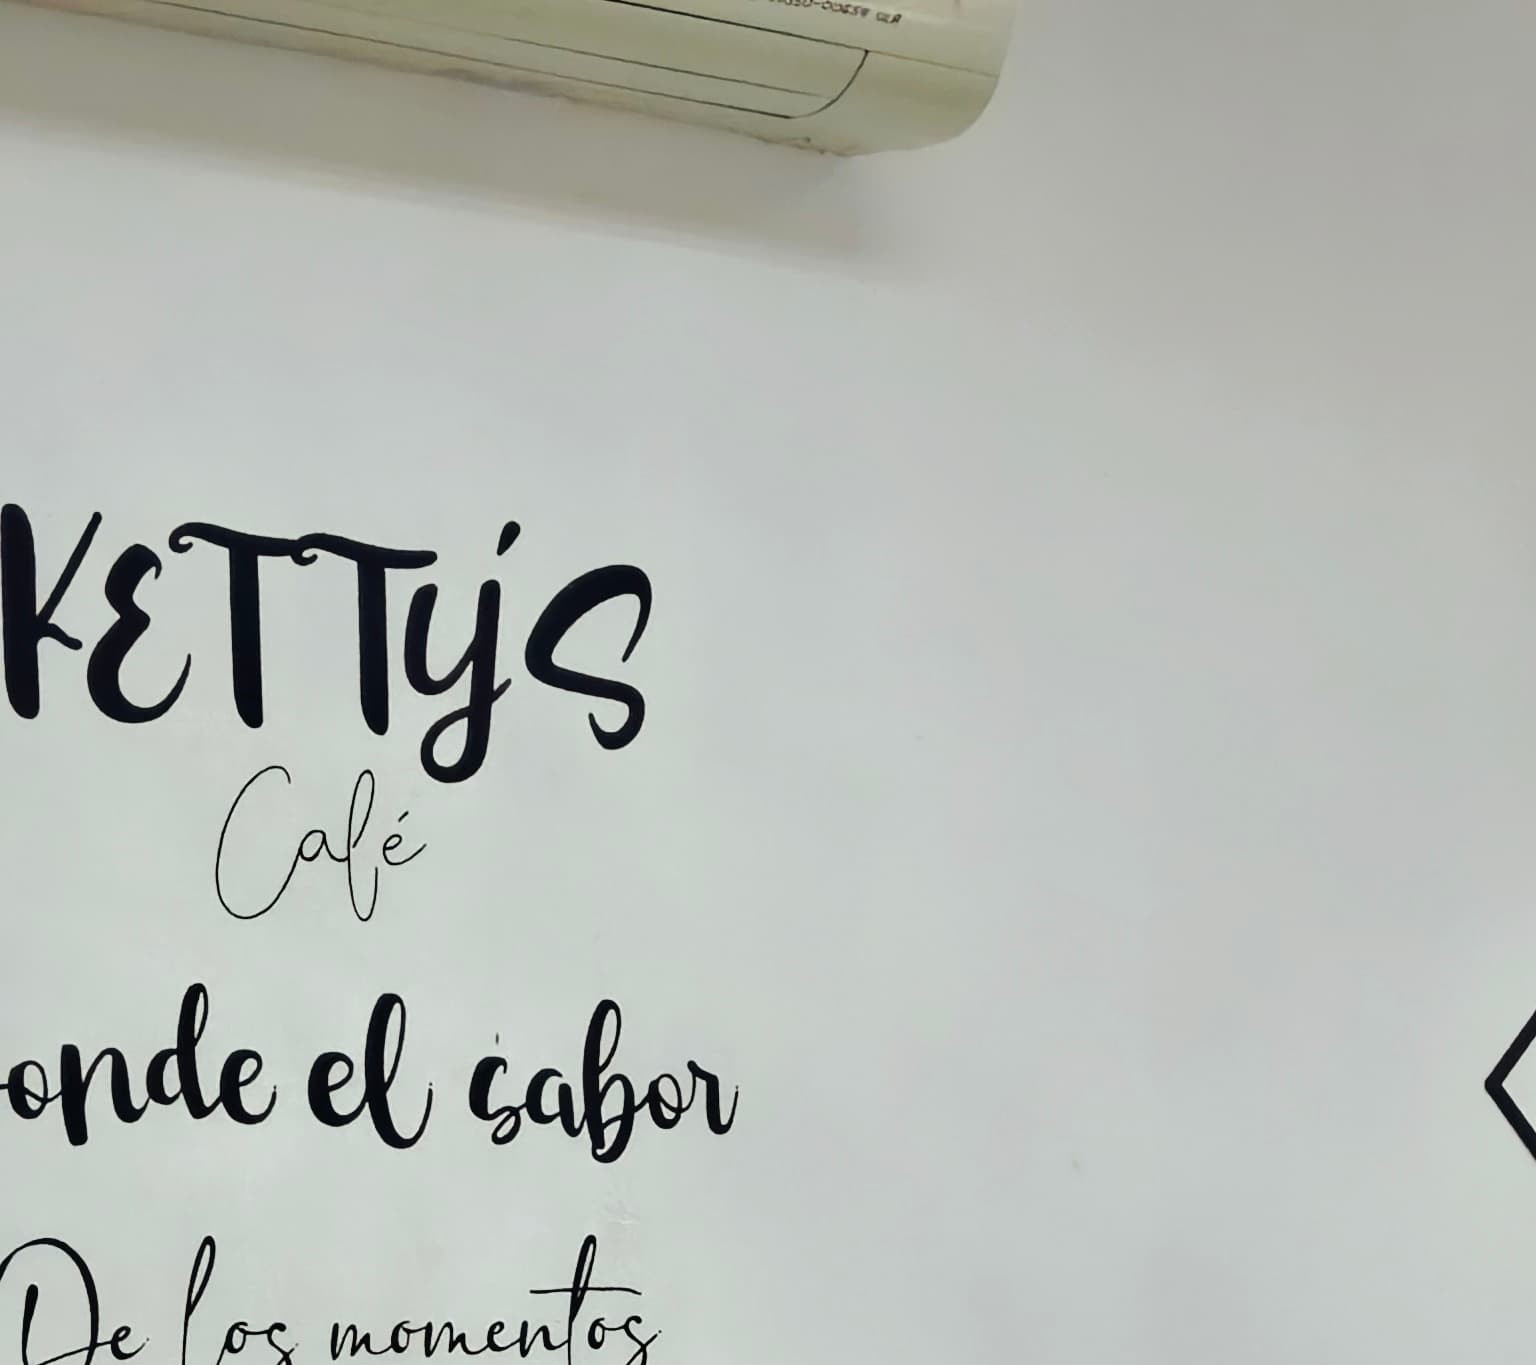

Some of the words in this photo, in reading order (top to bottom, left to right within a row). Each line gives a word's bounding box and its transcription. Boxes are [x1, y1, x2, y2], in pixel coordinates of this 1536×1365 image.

[216, 766, 426, 921] Café
[0, 983, 277, 1147] onde
[308, 993, 434, 1150] el
[469, 999, 739, 1164] sabor
